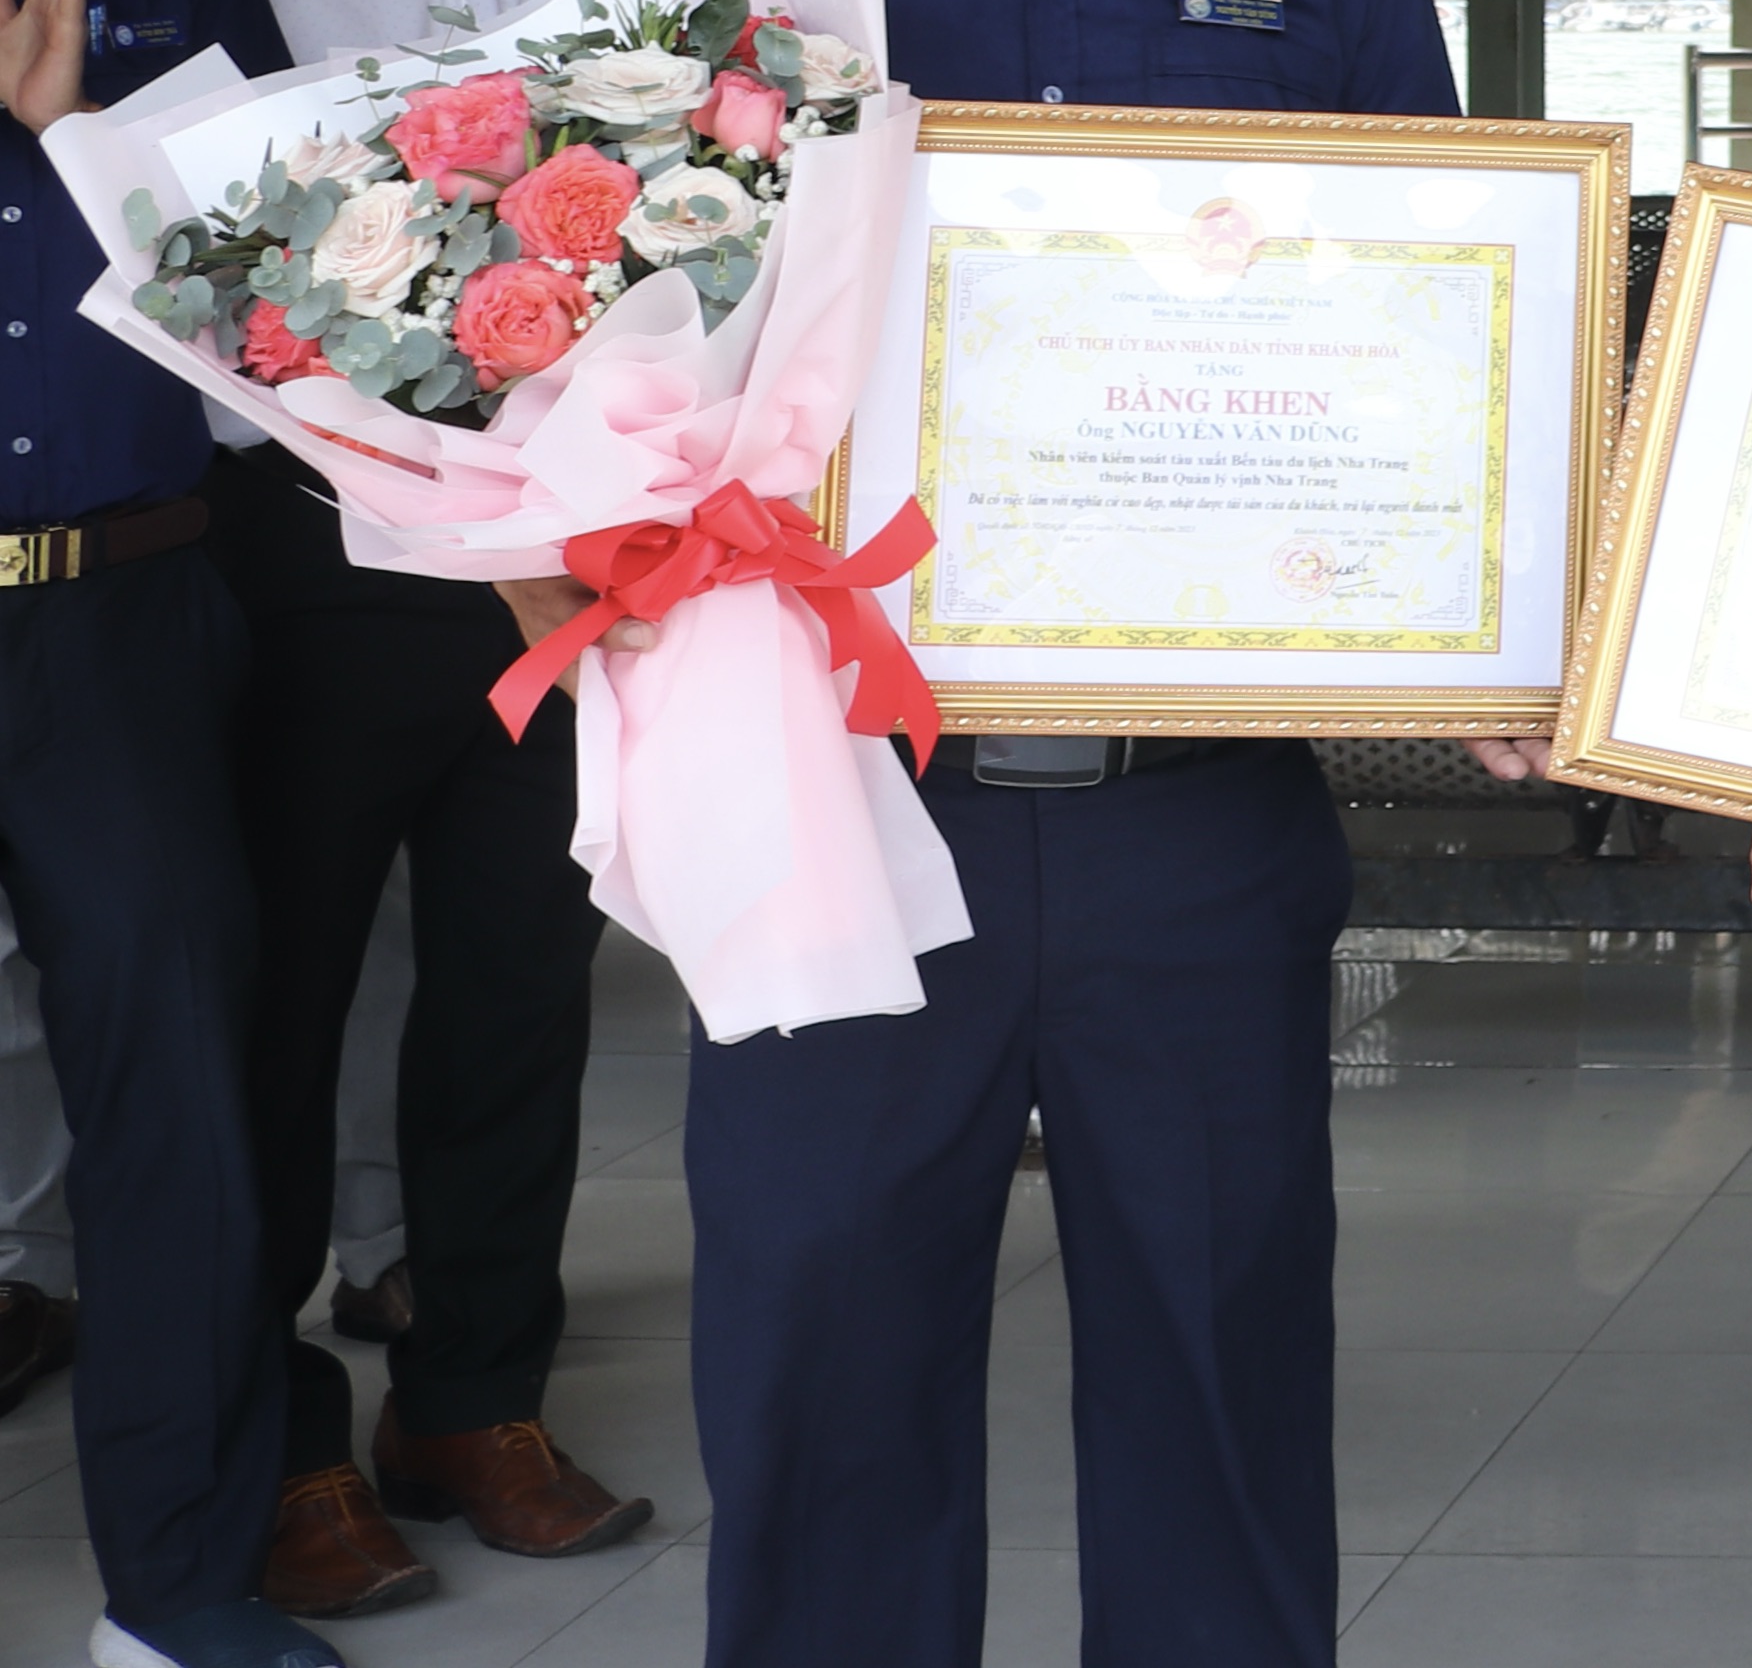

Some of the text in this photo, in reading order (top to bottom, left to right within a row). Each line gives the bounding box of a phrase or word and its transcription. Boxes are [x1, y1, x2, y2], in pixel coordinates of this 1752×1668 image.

[1037, 331, 1071, 350] CHỦ
[1075, 336, 1114, 351] TỊCH
[1143, 338, 1176, 352] BAN
[1180, 337, 1225, 353] NHÂN
[1228, 338, 1262, 355] DÂN
[1265, 338, 1303, 355] TỈNH
[1307, 340, 1363, 358] KHÁNH
[1367, 342, 1400, 359] HÒA
[1194, 361, 1244, 378] TẶNG
[1103, 373, 1332, 415] BẰNG KHEN
[1076, 417, 1359, 443] Ông NGUYỄN VĂN DŨNG
[1028, 450, 1408, 471] Nhân viên kiểm soát tàu xuất Bến tàu du lịch Nha Trang
[1099, 471, 1338, 489] thuộc Ban Quản lý vịnh Nha Trang
